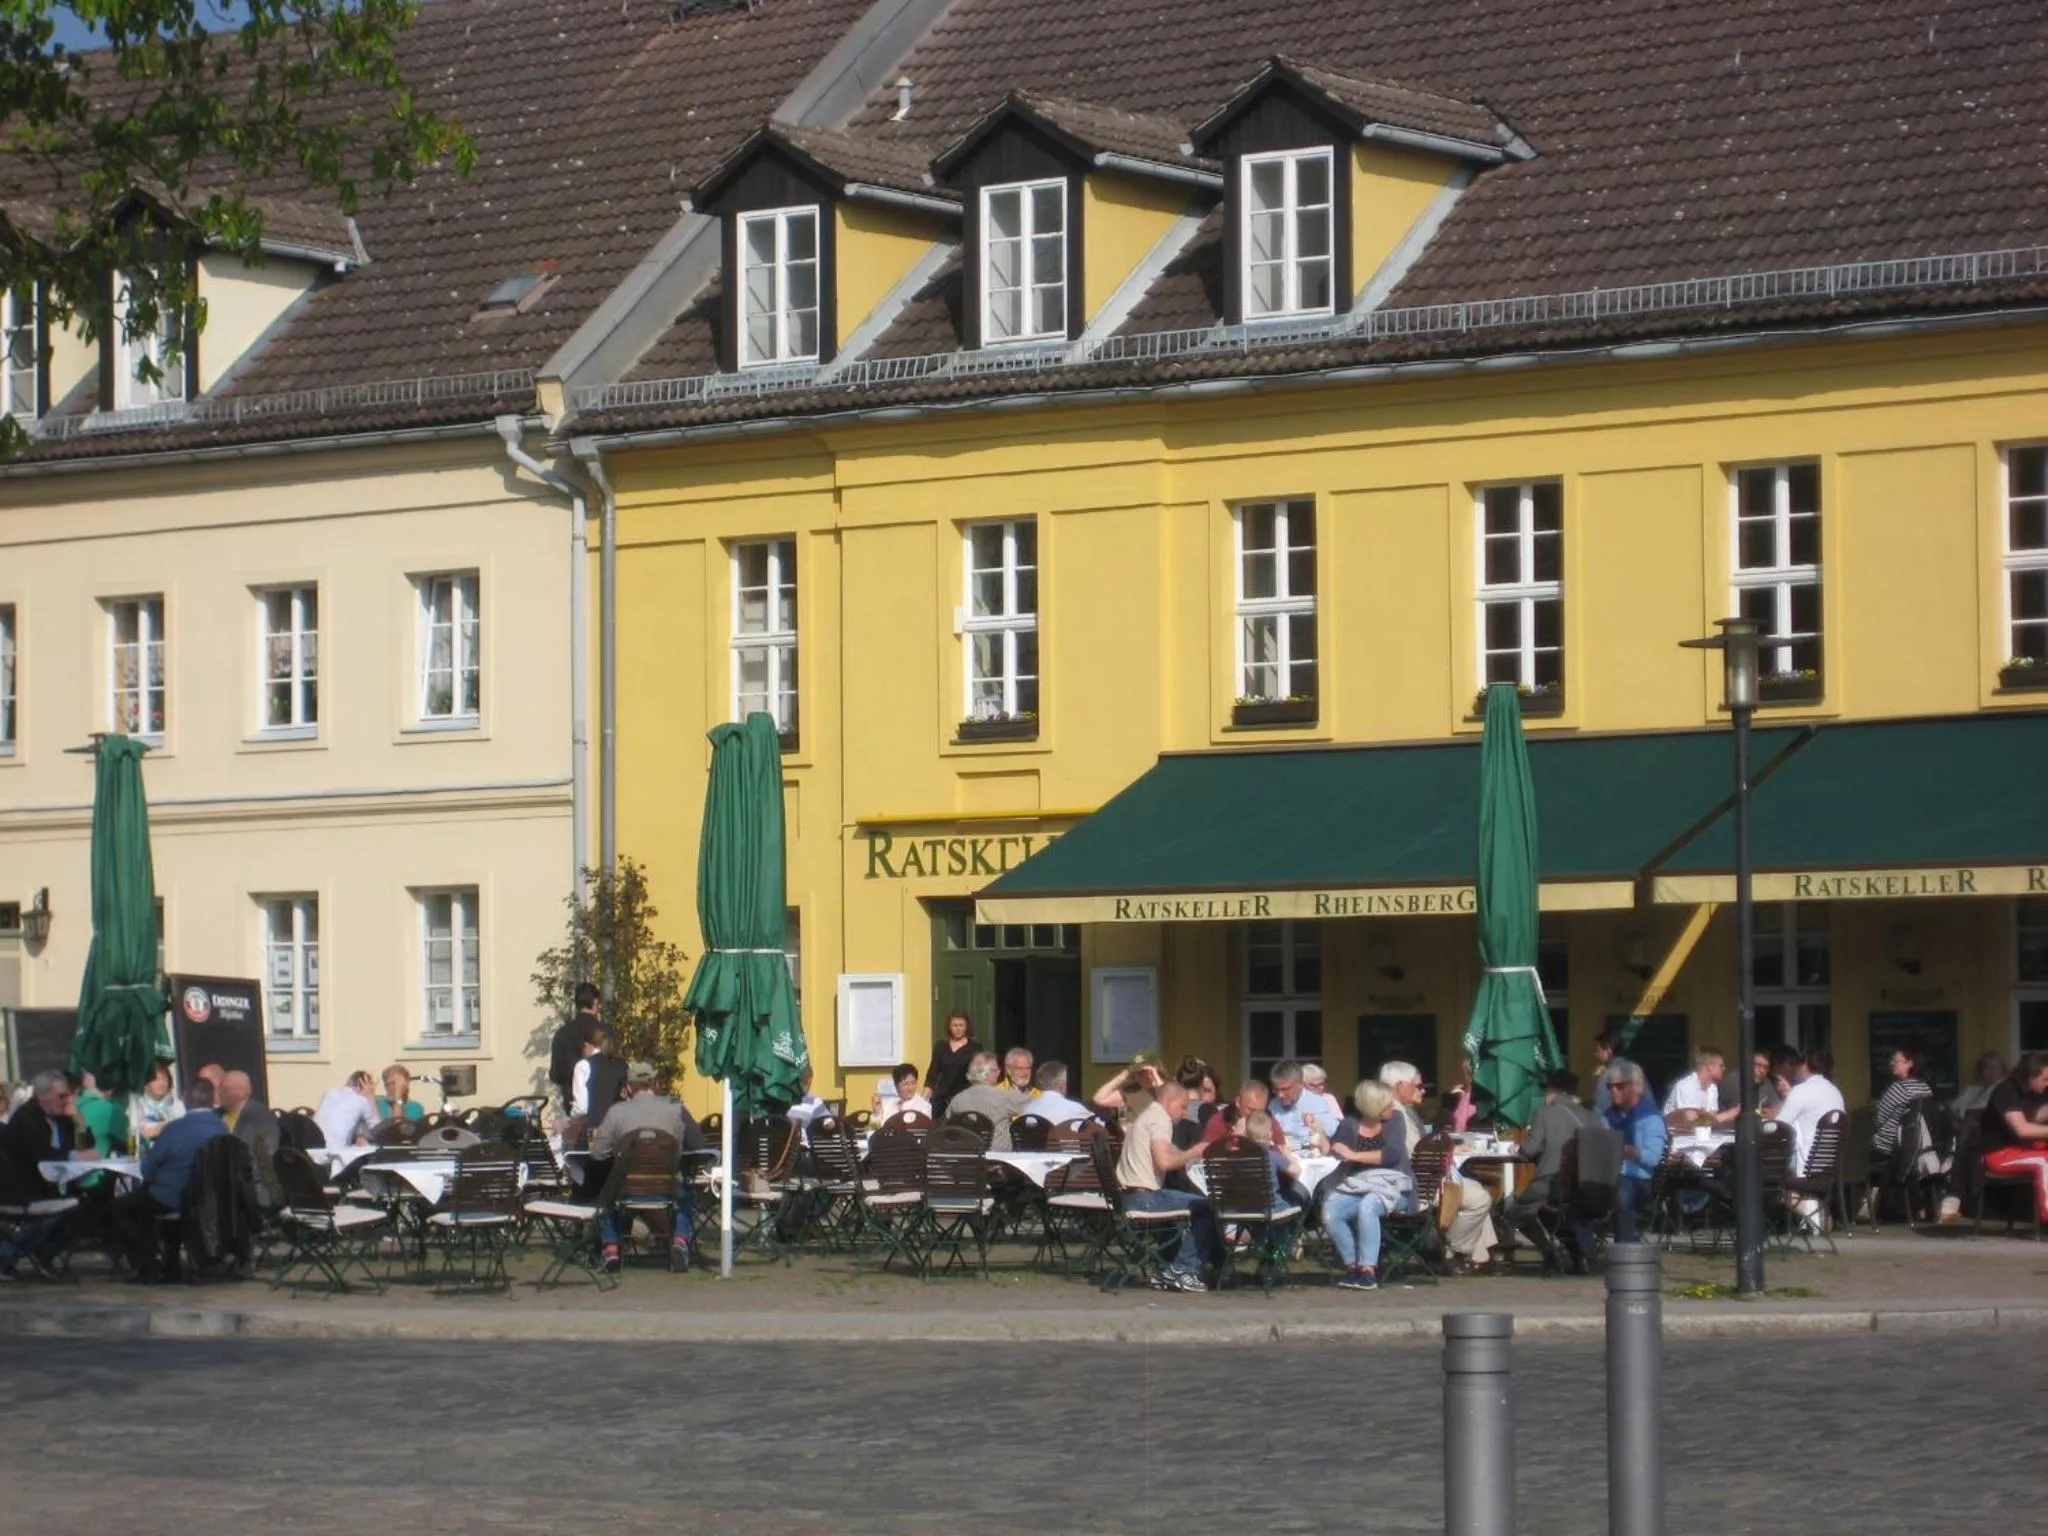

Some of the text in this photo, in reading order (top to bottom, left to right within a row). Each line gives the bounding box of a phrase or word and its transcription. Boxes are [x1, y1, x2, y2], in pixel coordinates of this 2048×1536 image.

[1794, 869, 1978, 898] RATSKELLER
[1114, 888, 1476, 920] RATSKELLER RHEINSBERG
